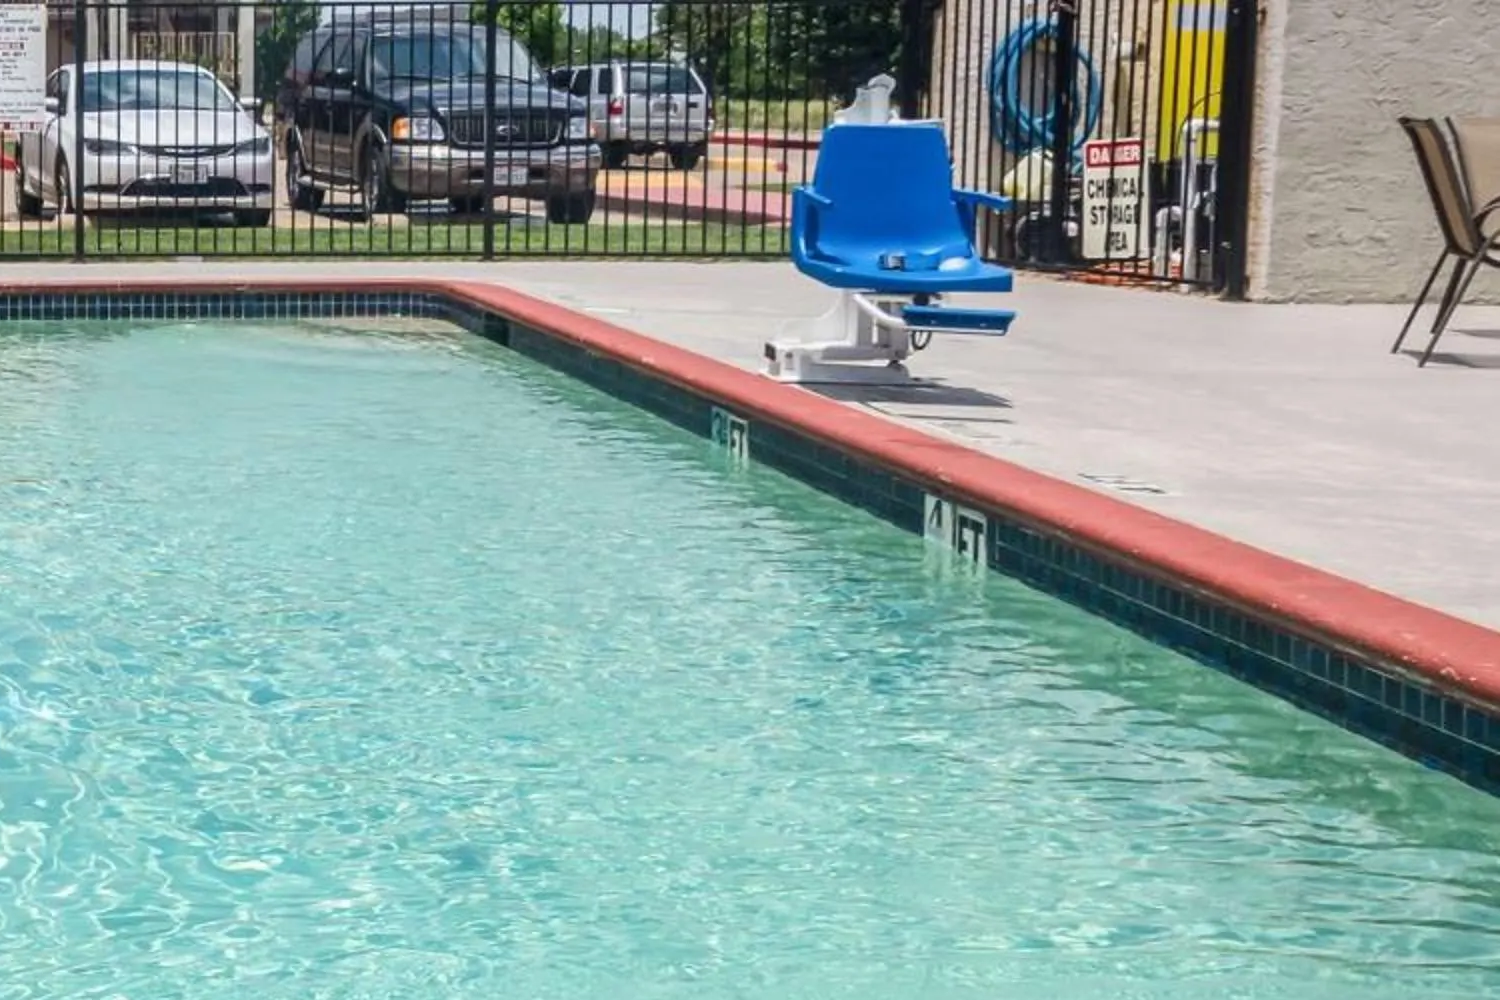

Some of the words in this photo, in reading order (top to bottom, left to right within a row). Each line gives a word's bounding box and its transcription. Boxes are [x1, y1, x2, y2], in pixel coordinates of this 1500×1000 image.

[1089, 144, 1141, 165] DAER
[1090, 203, 1141, 226] STRAG
[1106, 230, 1128, 252] REA
[958, 513, 985, 564] FT
